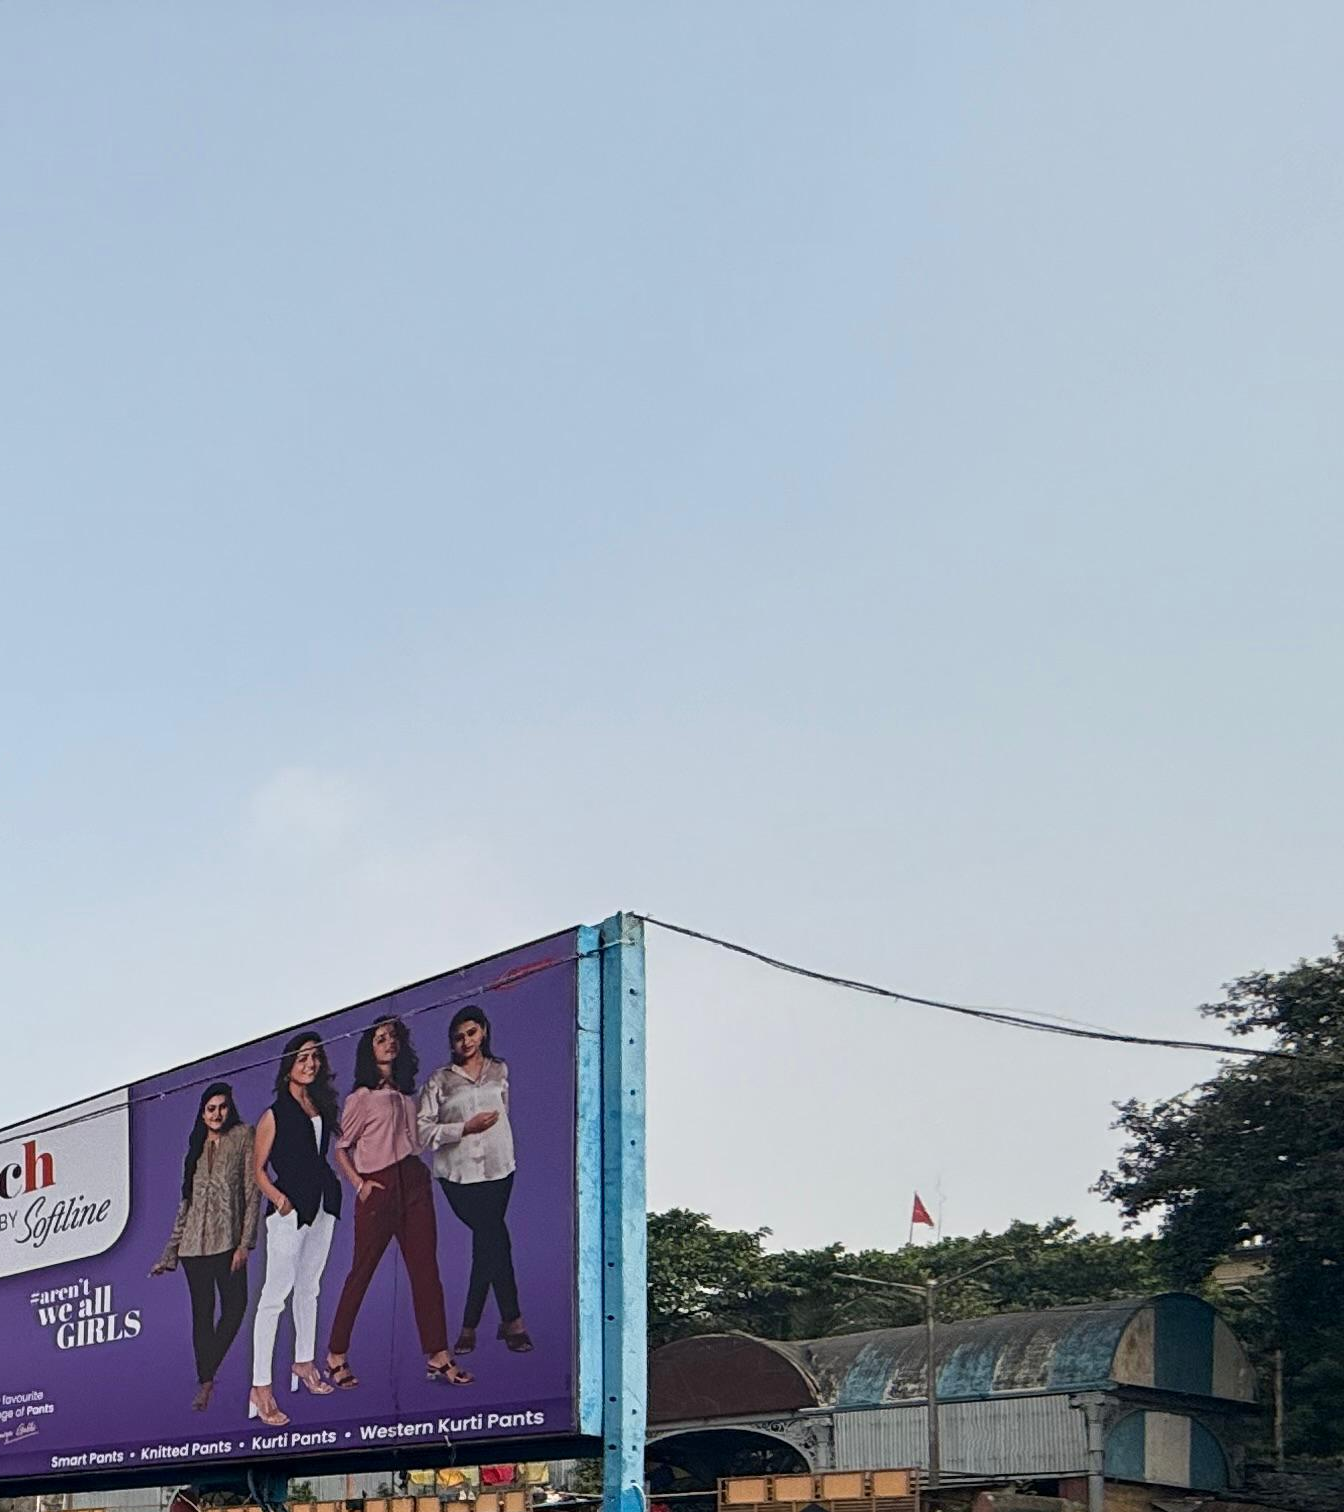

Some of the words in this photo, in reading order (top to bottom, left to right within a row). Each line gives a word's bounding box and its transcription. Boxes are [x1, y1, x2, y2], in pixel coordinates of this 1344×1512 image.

[15, 1195, 111, 1248] Softline
[38, 1302, 73, 1326] we
[78, 1285, 111, 1318] all
[56, 1310, 142, 1350] GIRLS
[2, 1391, 44, 1405] favourite
[15, 1406, 25, 1417] of
[26, 1403, 55, 1416] Pants
[51, 1453, 88, 1468] Smart
[89, 1450, 124, 1464] Pants
[141, 1443, 189, 1460] Knitted
[192, 1441, 232, 1456] Pants
[252, 1432, 288, 1450] Kurti
[291, 1430, 337, 1447] Pants
[360, 1423, 434, 1440] Western
[438, 1413, 483, 1433] Kurti
[487, 1410, 545, 1429] Pants
